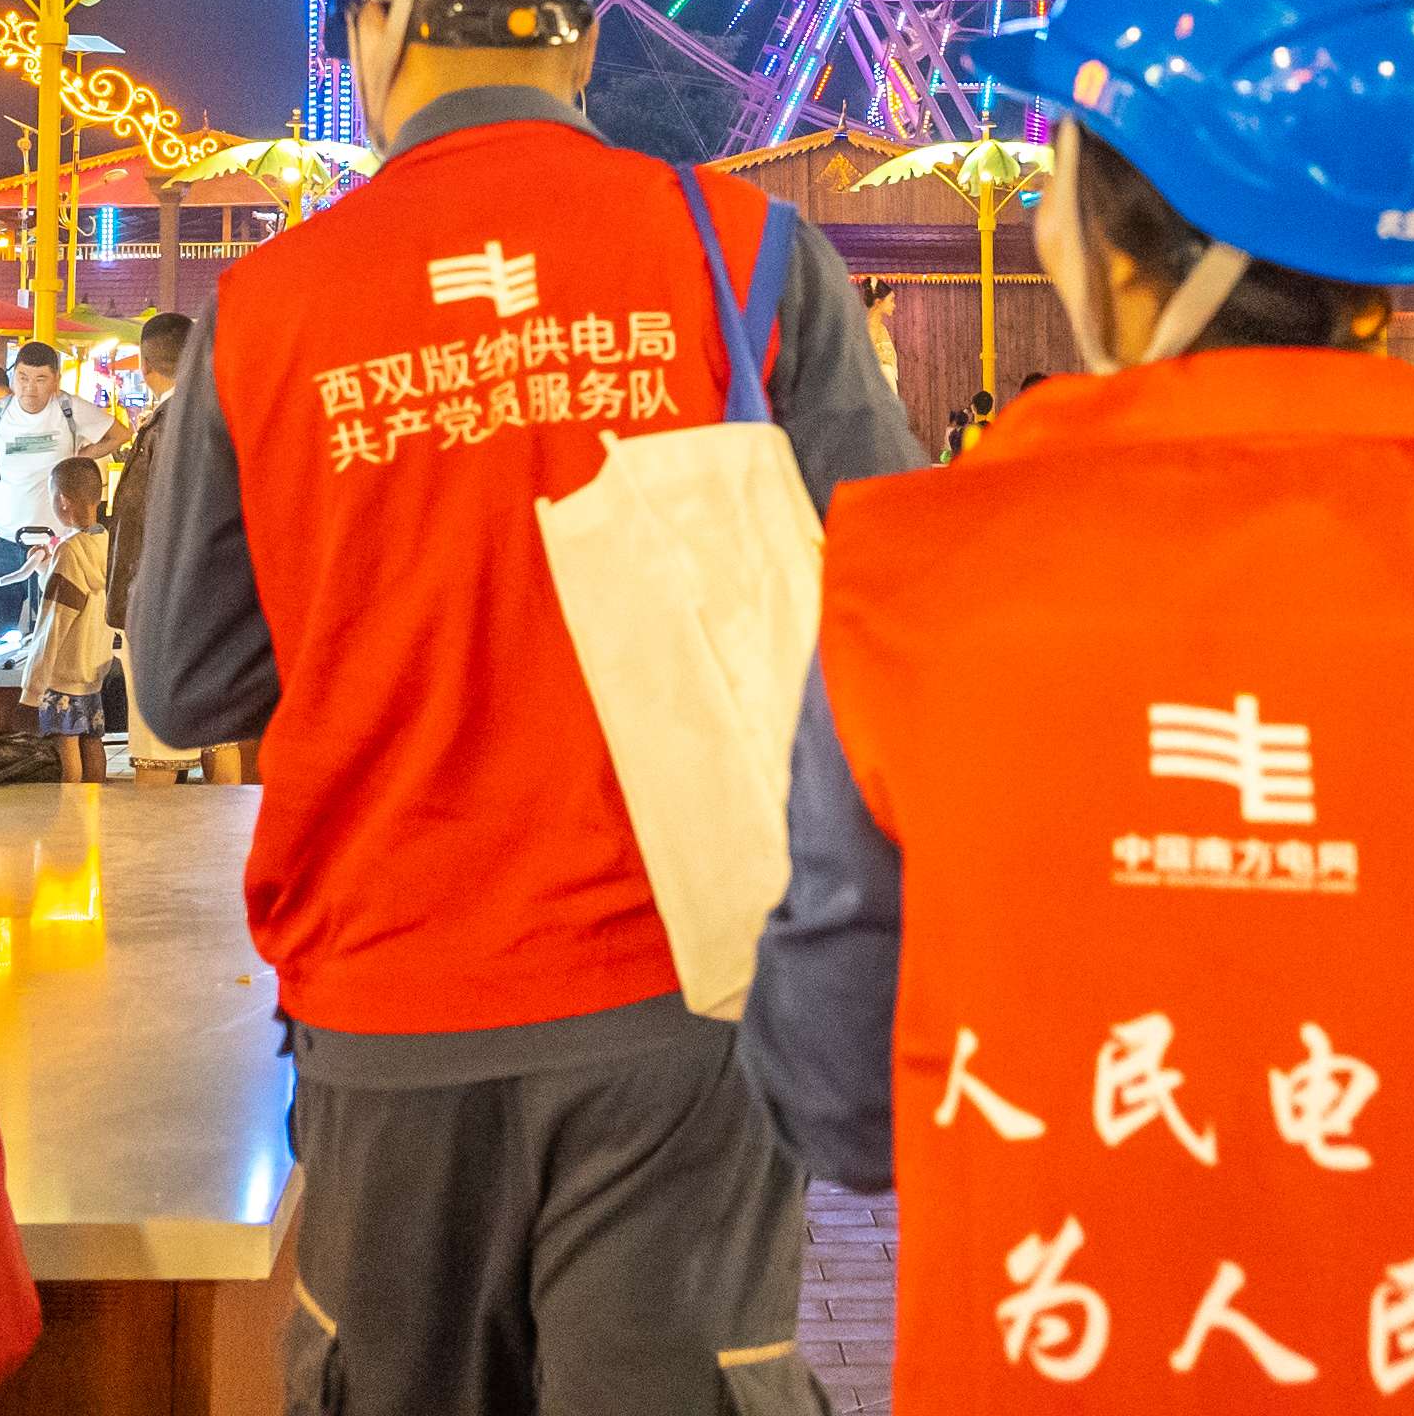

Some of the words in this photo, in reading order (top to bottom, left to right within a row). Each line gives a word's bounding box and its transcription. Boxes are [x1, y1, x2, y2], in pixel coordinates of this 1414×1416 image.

[313, 311, 677, 418] 西双版纳供电局
[330, 368, 680, 473] 共产党员服务队
[1111, 833, 1359, 878] 中国南方电网
